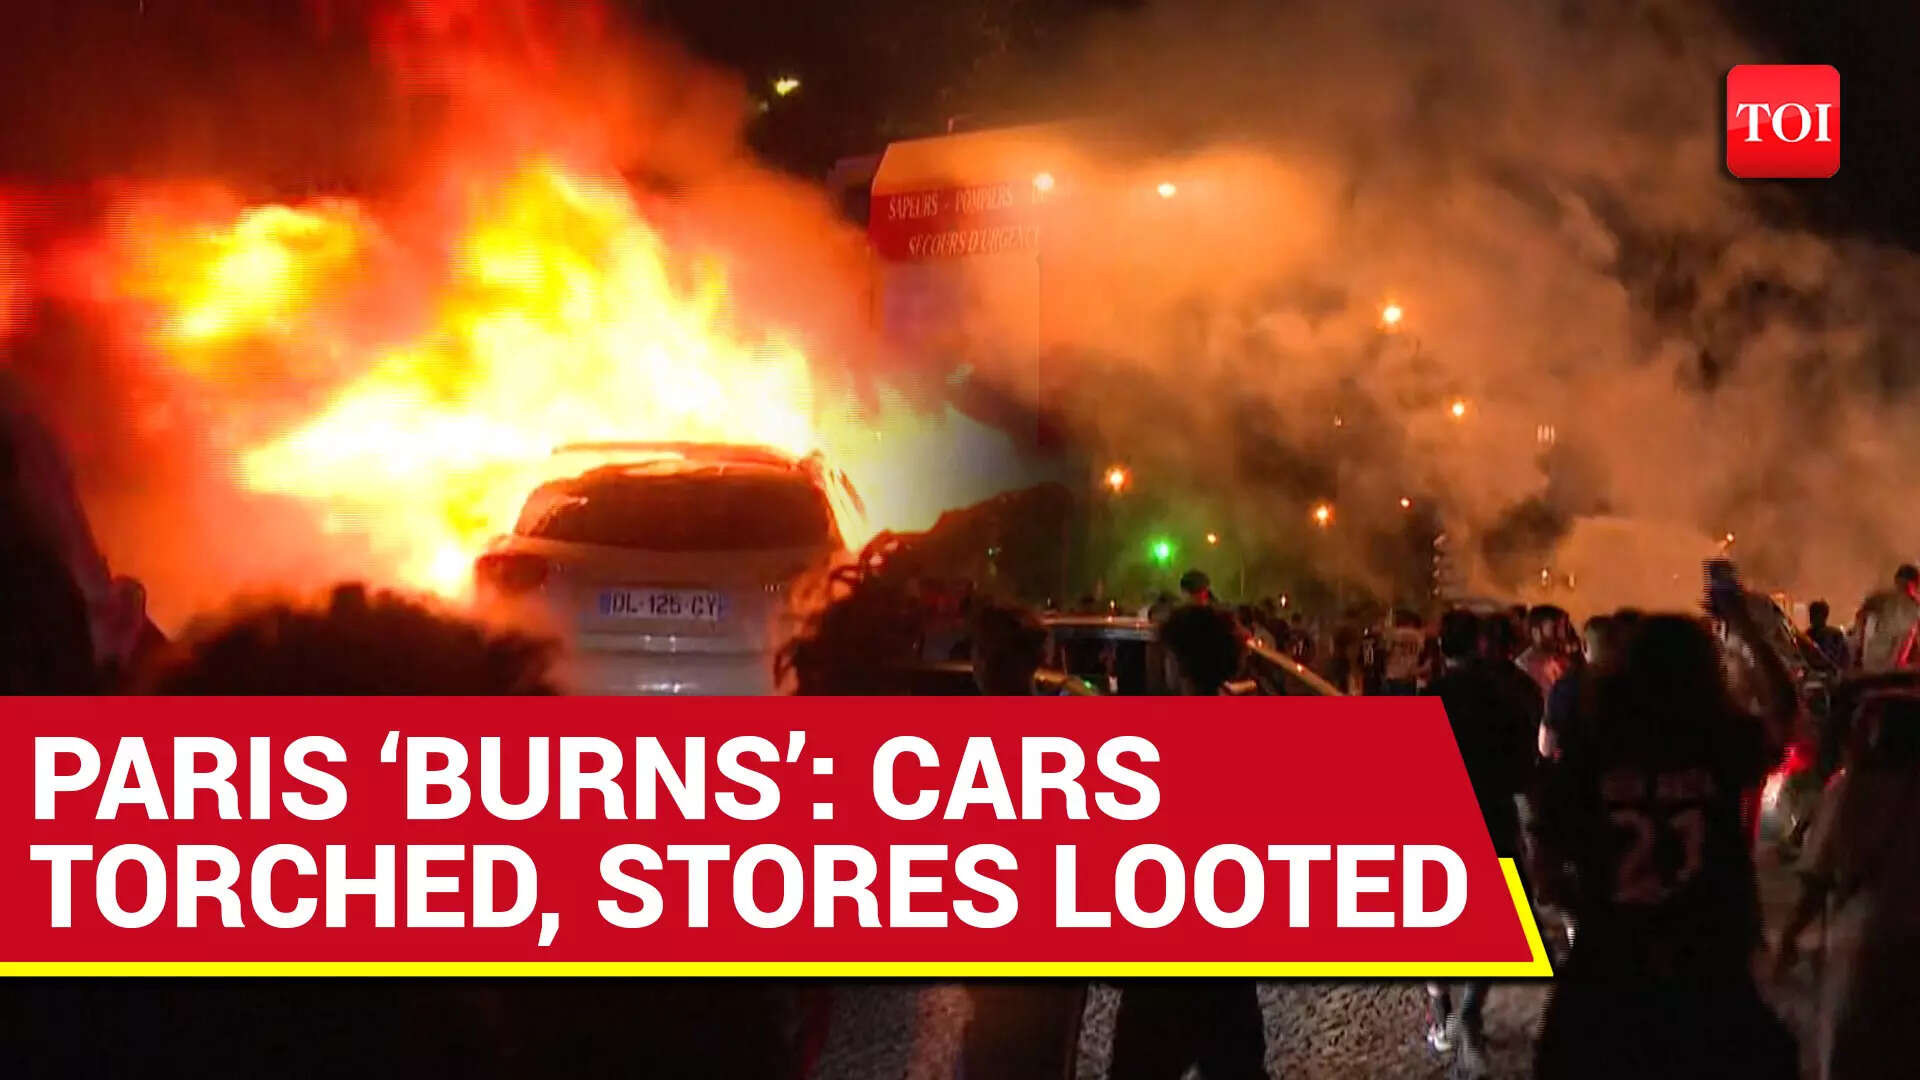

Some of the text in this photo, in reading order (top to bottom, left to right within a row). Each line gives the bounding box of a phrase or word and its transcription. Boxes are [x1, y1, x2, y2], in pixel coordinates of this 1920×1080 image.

[888, 193, 939, 221] SAPEURS
[954, 184, 1014, 214] POMPIERS
[907, 230, 965, 257] SECOURS
